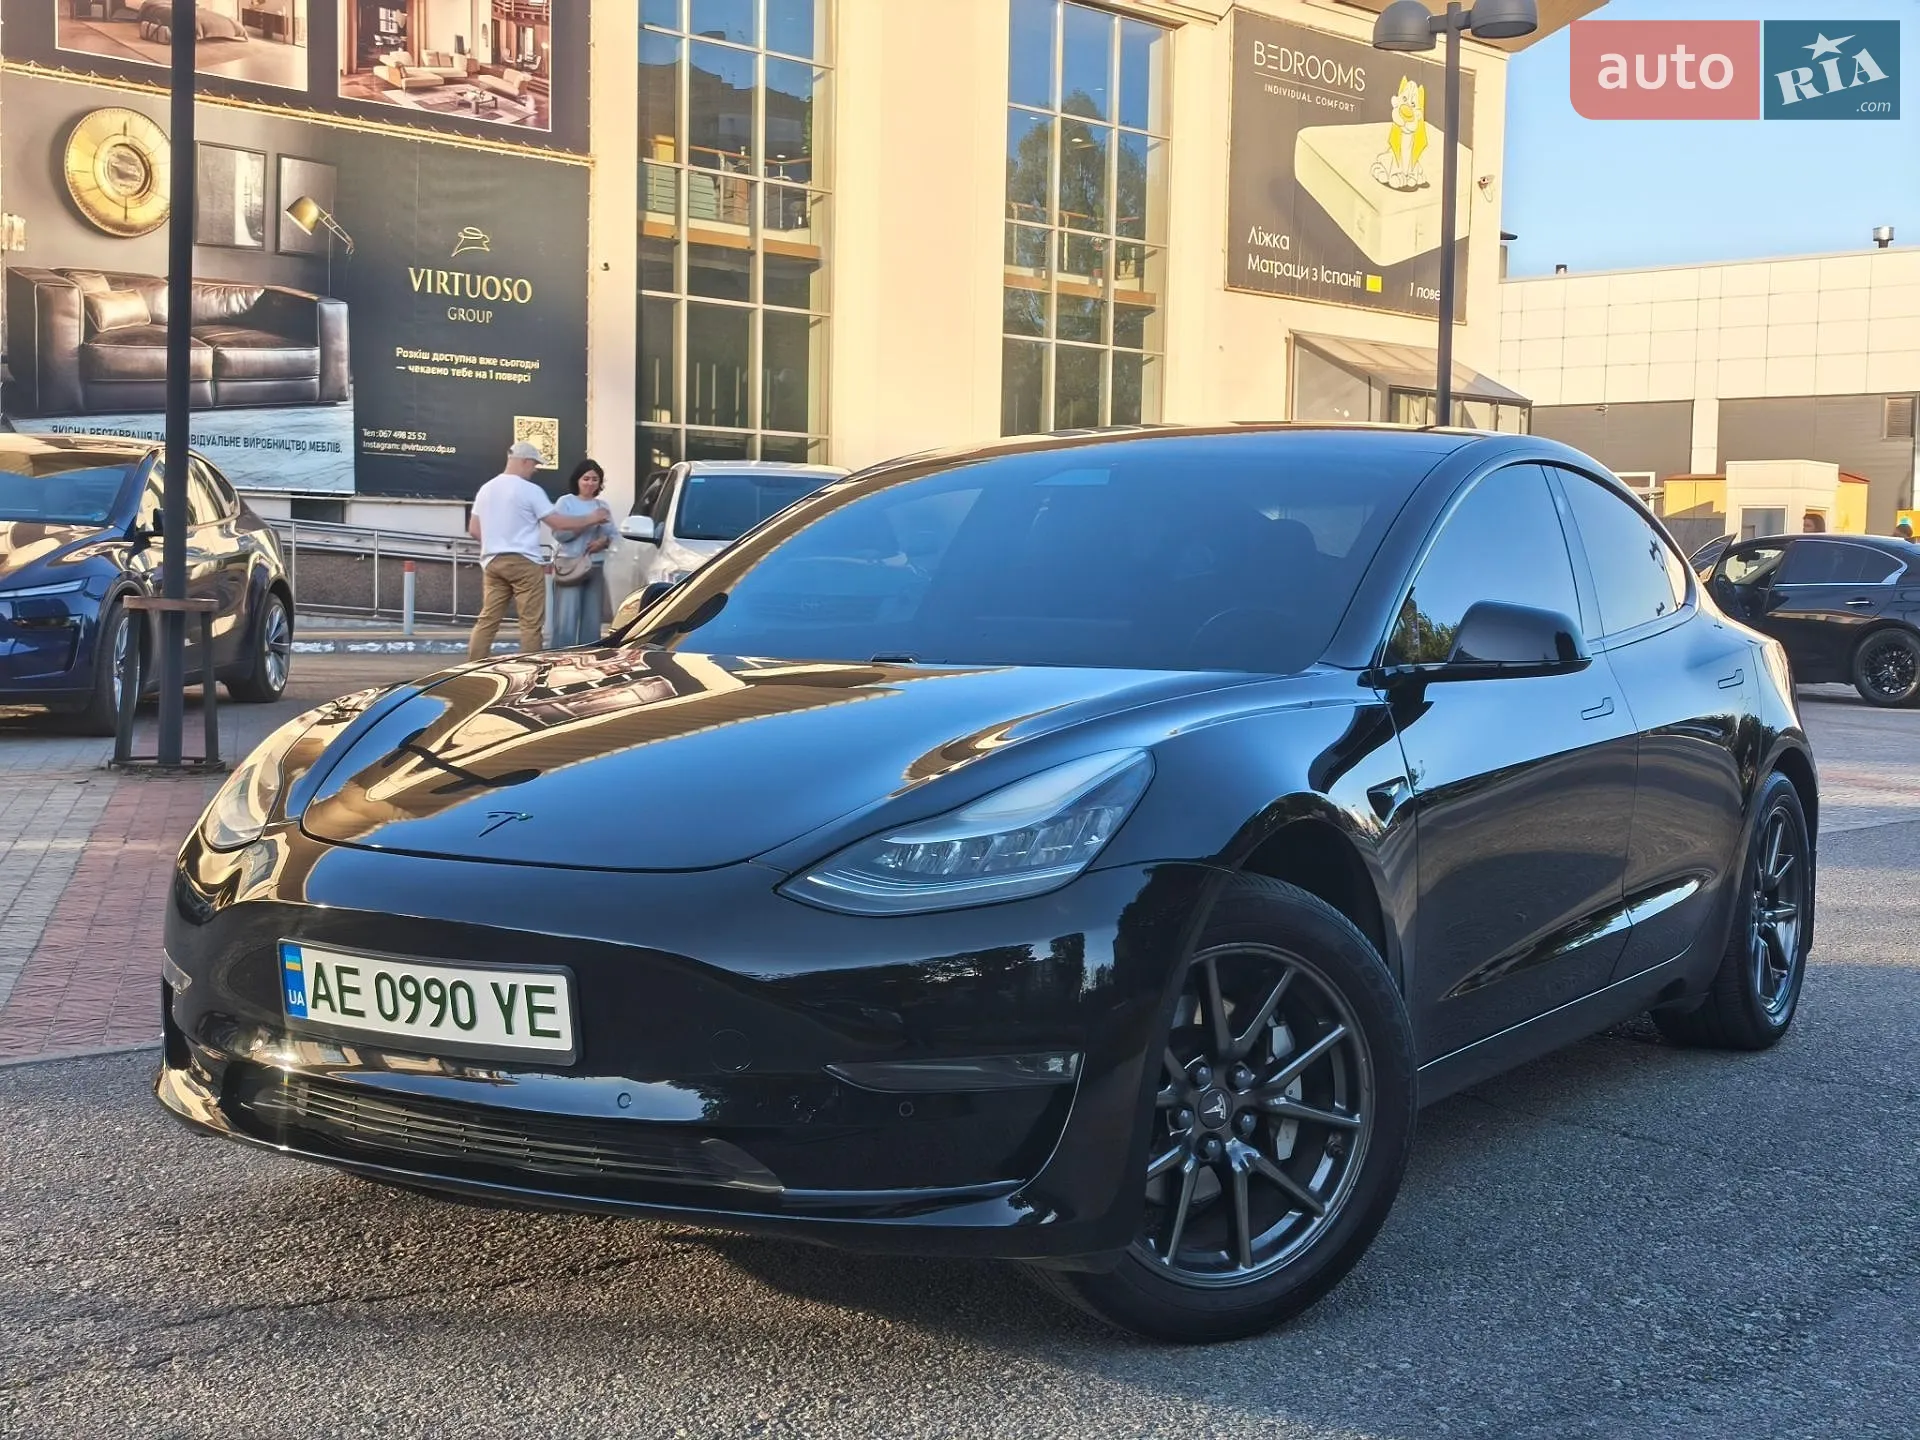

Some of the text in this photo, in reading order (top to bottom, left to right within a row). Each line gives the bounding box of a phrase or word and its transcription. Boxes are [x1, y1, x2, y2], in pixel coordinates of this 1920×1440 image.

[1254, 40, 1366, 92] BEDROOMS
[1264, 83, 1356, 113] INDIVIDUAL COMFORT
[1248, 225, 1290, 251] Ліжка
[1248, 253, 1363, 289] Матраци з Іспанії
[408, 266, 532, 304] VIRTUOSO
[1409, 282, 1441, 301] 1 пове
[447, 306, 493, 323] GROUP
[395, 346, 540, 371] Розкіш доступна вже сьогодні
[408, 364, 449, 376] чекаємо
[451, 367, 473, 378] тебе
[475, 370, 487, 380] на
[495, 372, 532, 384] поверсі
[190, 434, 241, 448] ВІДУАЛЬНЕ
[243, 437, 306, 452] ВИРОБНИЦТВО
[308, 441, 343, 453] МЕБЛІВ.
[362, 440, 457, 454] Instagram: @virtuoso.dp.ua
[288, 989, 305, 1007] UA
[311, 961, 561, 1039] AE 0990 YE
